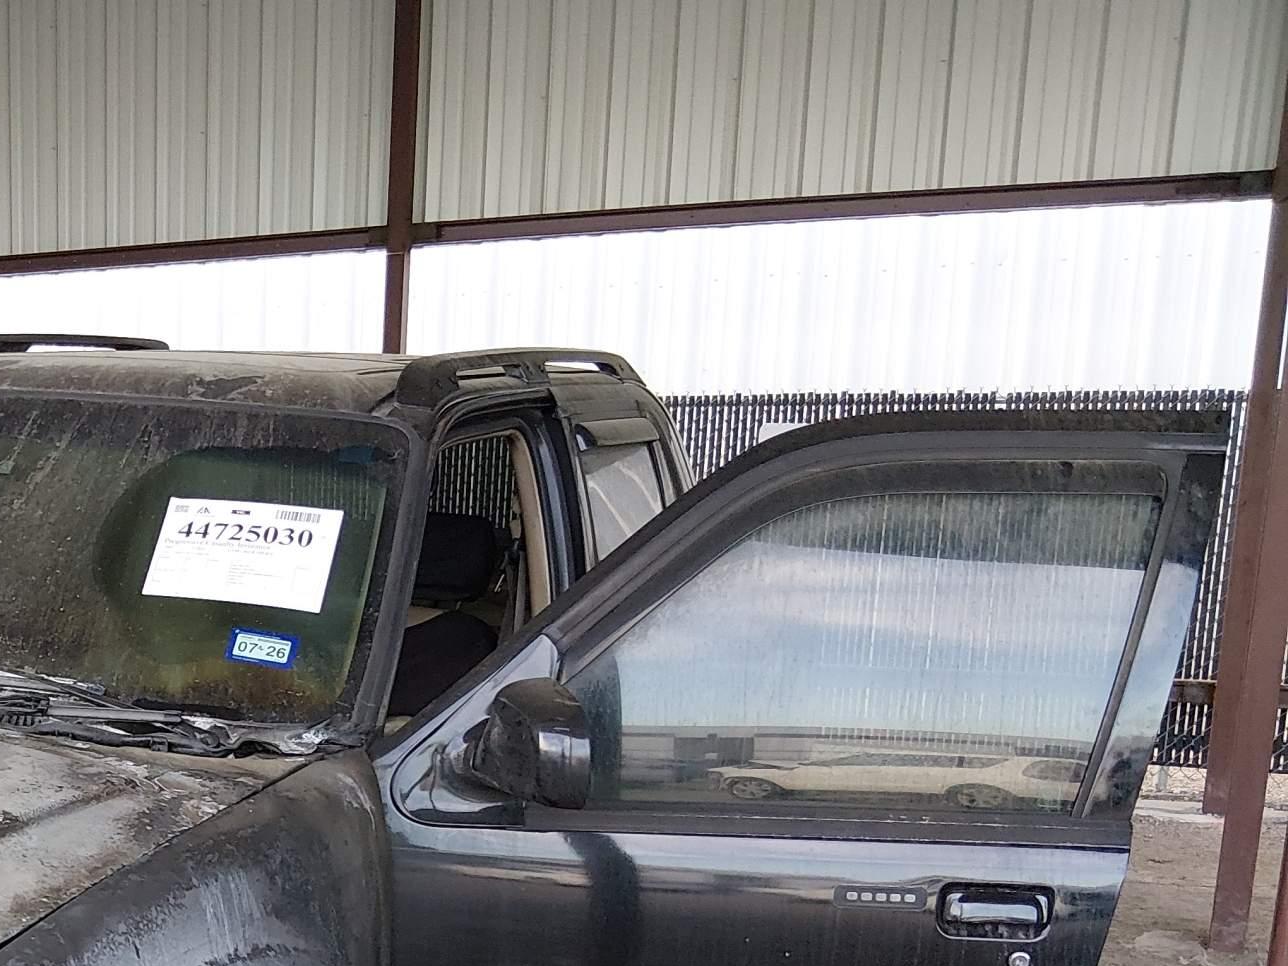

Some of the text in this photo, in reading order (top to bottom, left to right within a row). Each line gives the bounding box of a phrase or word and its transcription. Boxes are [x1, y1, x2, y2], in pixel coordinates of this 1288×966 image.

[178, 521, 313, 548] 44725030
[238, 641, 259, 654] 07
[265, 645, 287, 659] 26
